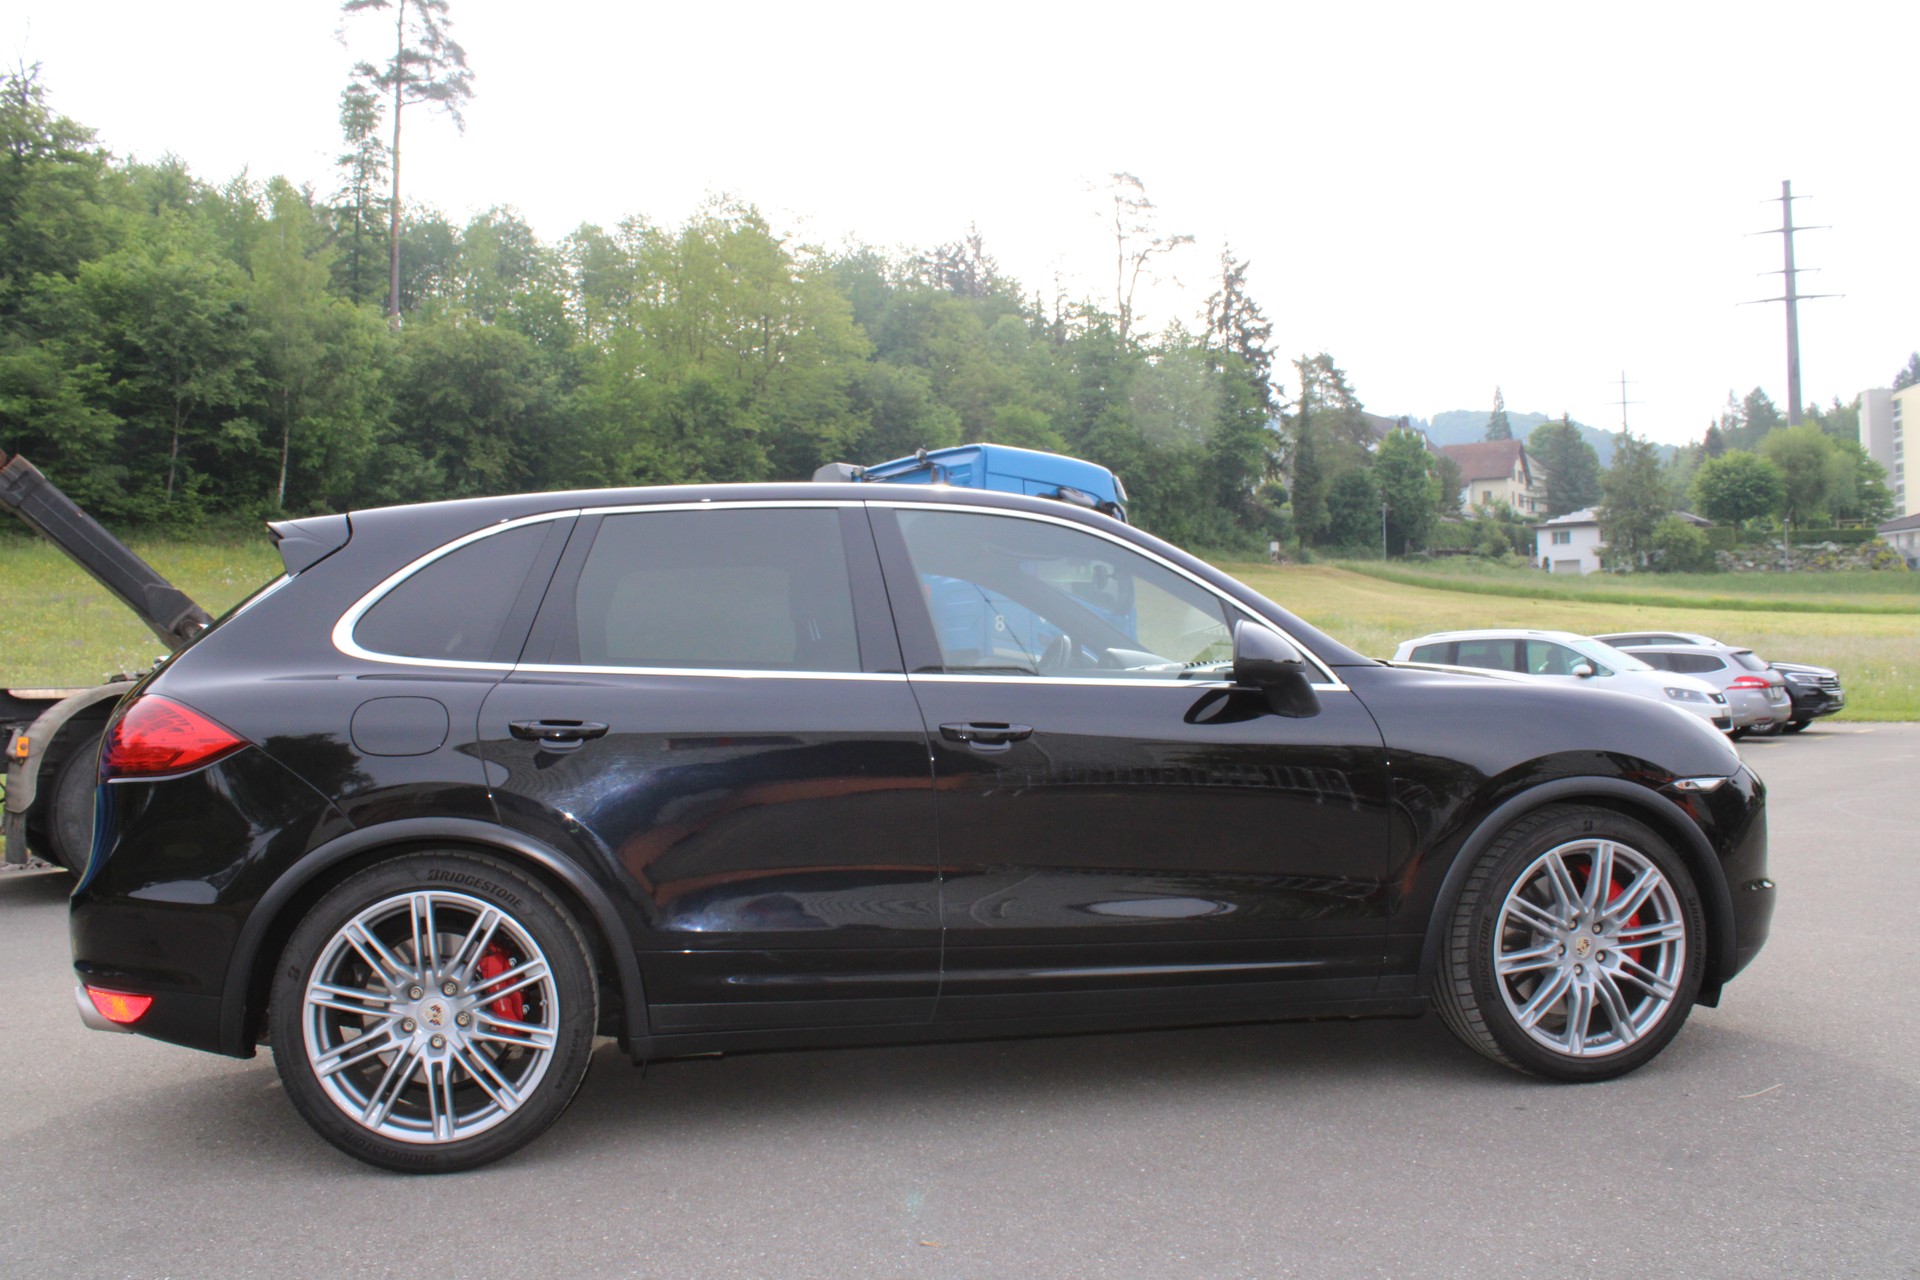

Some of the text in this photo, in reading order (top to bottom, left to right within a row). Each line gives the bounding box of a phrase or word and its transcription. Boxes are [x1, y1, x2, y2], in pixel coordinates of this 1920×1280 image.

[995, 615, 1006, 632] 8
[427, 868, 524, 909] BRIDGESTONE
[1478, 913, 1496, 1002] BRIDGESTONE
